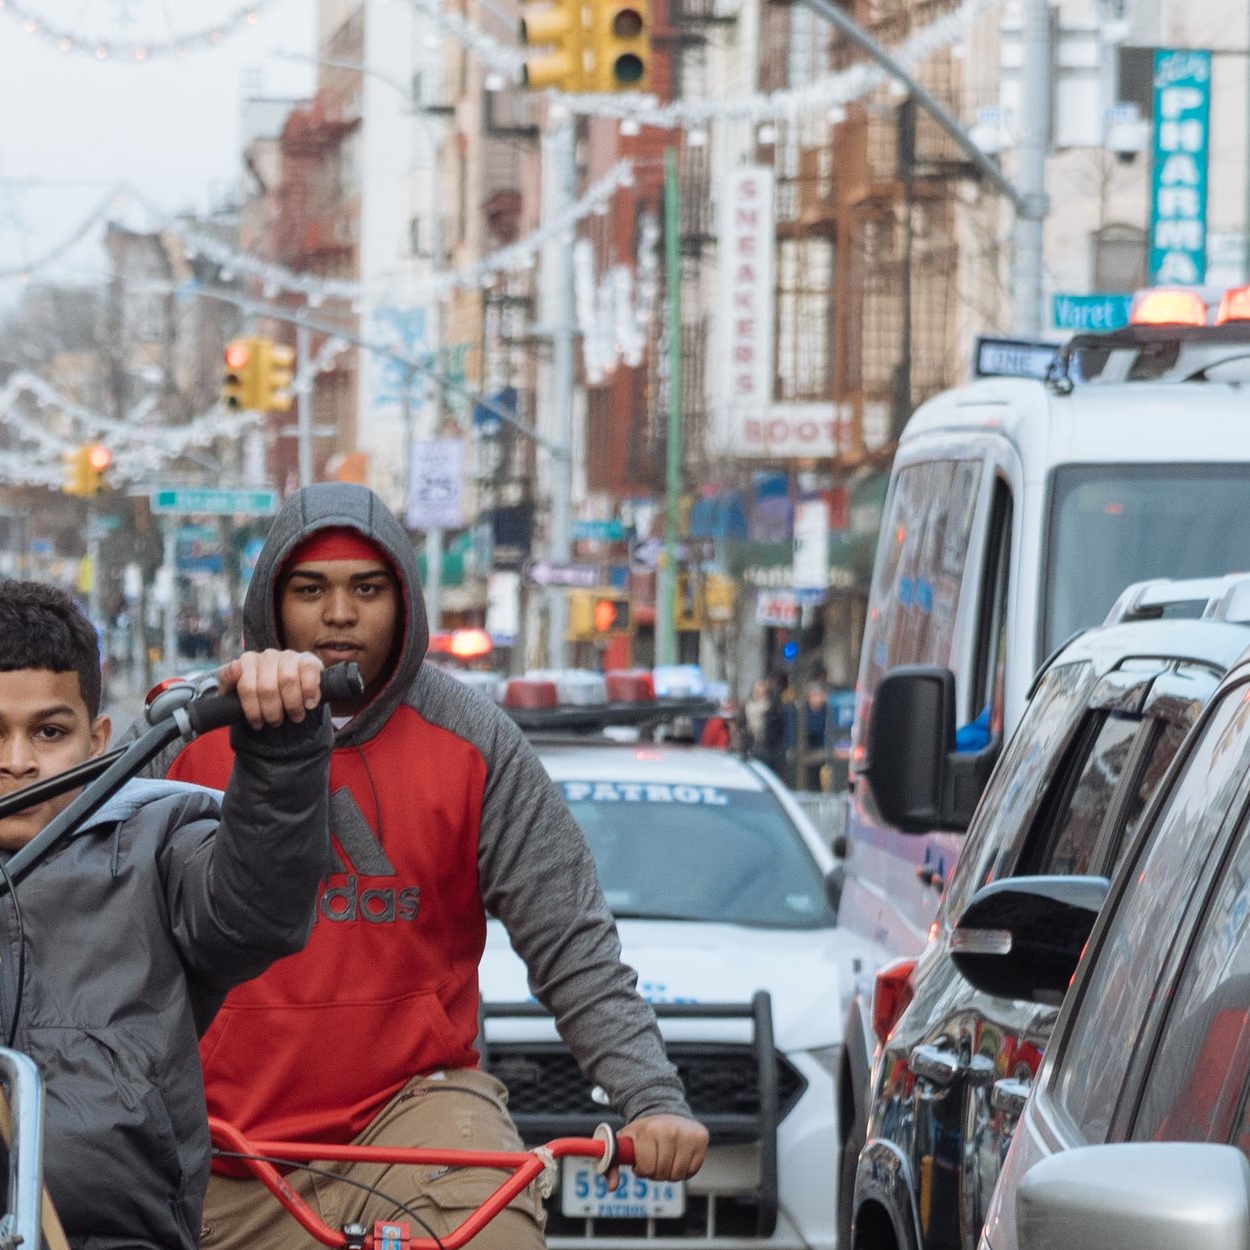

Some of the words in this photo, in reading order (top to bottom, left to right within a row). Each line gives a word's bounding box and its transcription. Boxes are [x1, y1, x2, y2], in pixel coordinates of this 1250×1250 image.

[733, 179, 758, 394] SNEAKERS
[1056, 299, 1114, 328] Varet
[564, 782, 728, 806] PATROL
[318, 874, 421, 923] das
[597, 1204, 648, 1217] PATROL
